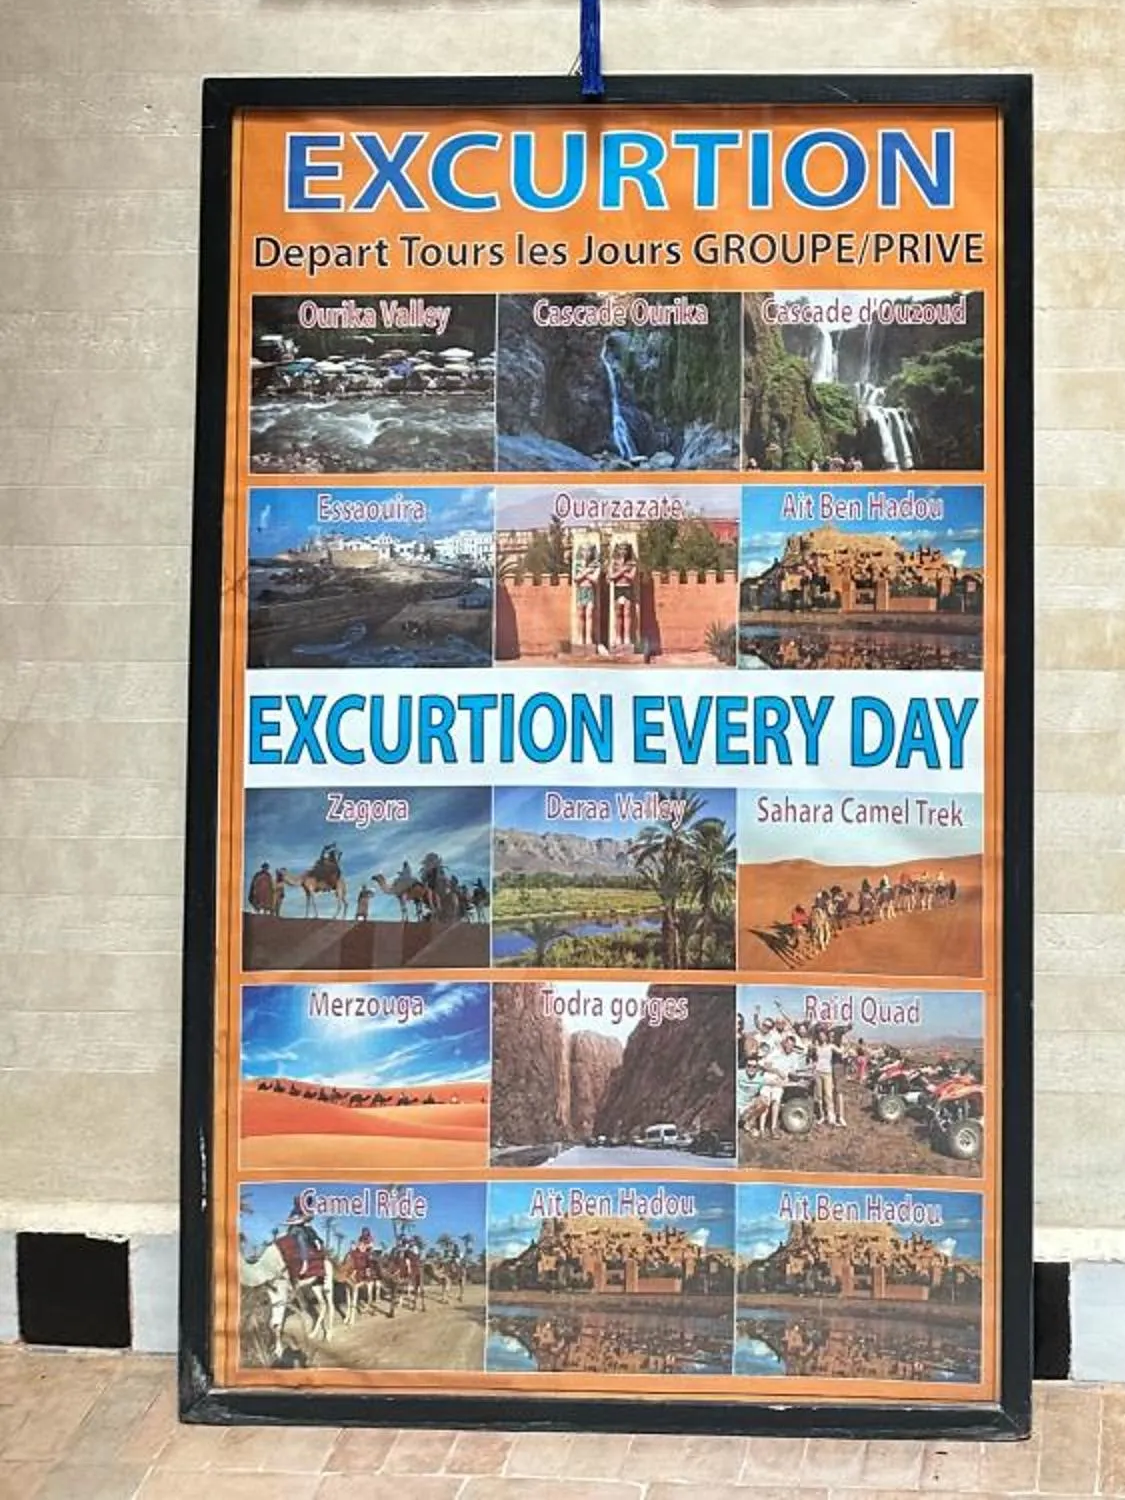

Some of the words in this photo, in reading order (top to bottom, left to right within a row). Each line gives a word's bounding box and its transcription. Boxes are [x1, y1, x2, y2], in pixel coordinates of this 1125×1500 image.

[285, 129, 955, 211] EXCURTION
[253, 237, 388, 276] Depart
[399, 235, 503, 269] Tours
[516, 231, 567, 268] les
[578, 231, 681, 267] Jours
[694, 230, 985, 267] GROUPE/PRIVE
[298, 300, 376, 329] Ourika
[380, 299, 451, 336] Valley
[533, 299, 627, 328] Cascade
[630, 299, 709, 328] Ourika
[762, 298, 854, 326] Cascade
[858, 297, 967, 326] d'Ouzoud
[317, 493, 426, 524] Essaouira
[555, 492, 683, 520] Ouarzazate
[820, 492, 863, 520] Ben
[868, 492, 944, 520] Hadou
[248, 692, 613, 765] EXCURTION
[633, 694, 834, 767] EVERY
[851, 696, 979, 770] DAY
[325, 792, 410, 828] Zagora
[546, 792, 610, 820] Daraa
[616, 791, 688, 828] Valley
[757, 795, 833, 823] Sahara
[841, 797, 909, 825] Camel
[916, 798, 964, 827] Trek
[308, 991, 424, 1023] Merzouga
[542, 990, 603, 1016] Todra
[611, 997, 690, 1026] gorges
[860, 997, 921, 1027] Quad
[299, 1187, 370, 1218] Camel
[375, 1188, 428, 1219] Ride
[572, 1187, 611, 1217] Ben
[617, 1187, 695, 1218] Hadou
[817, 1194, 857, 1222] Ben
[866, 1195, 944, 1226] Hadou
